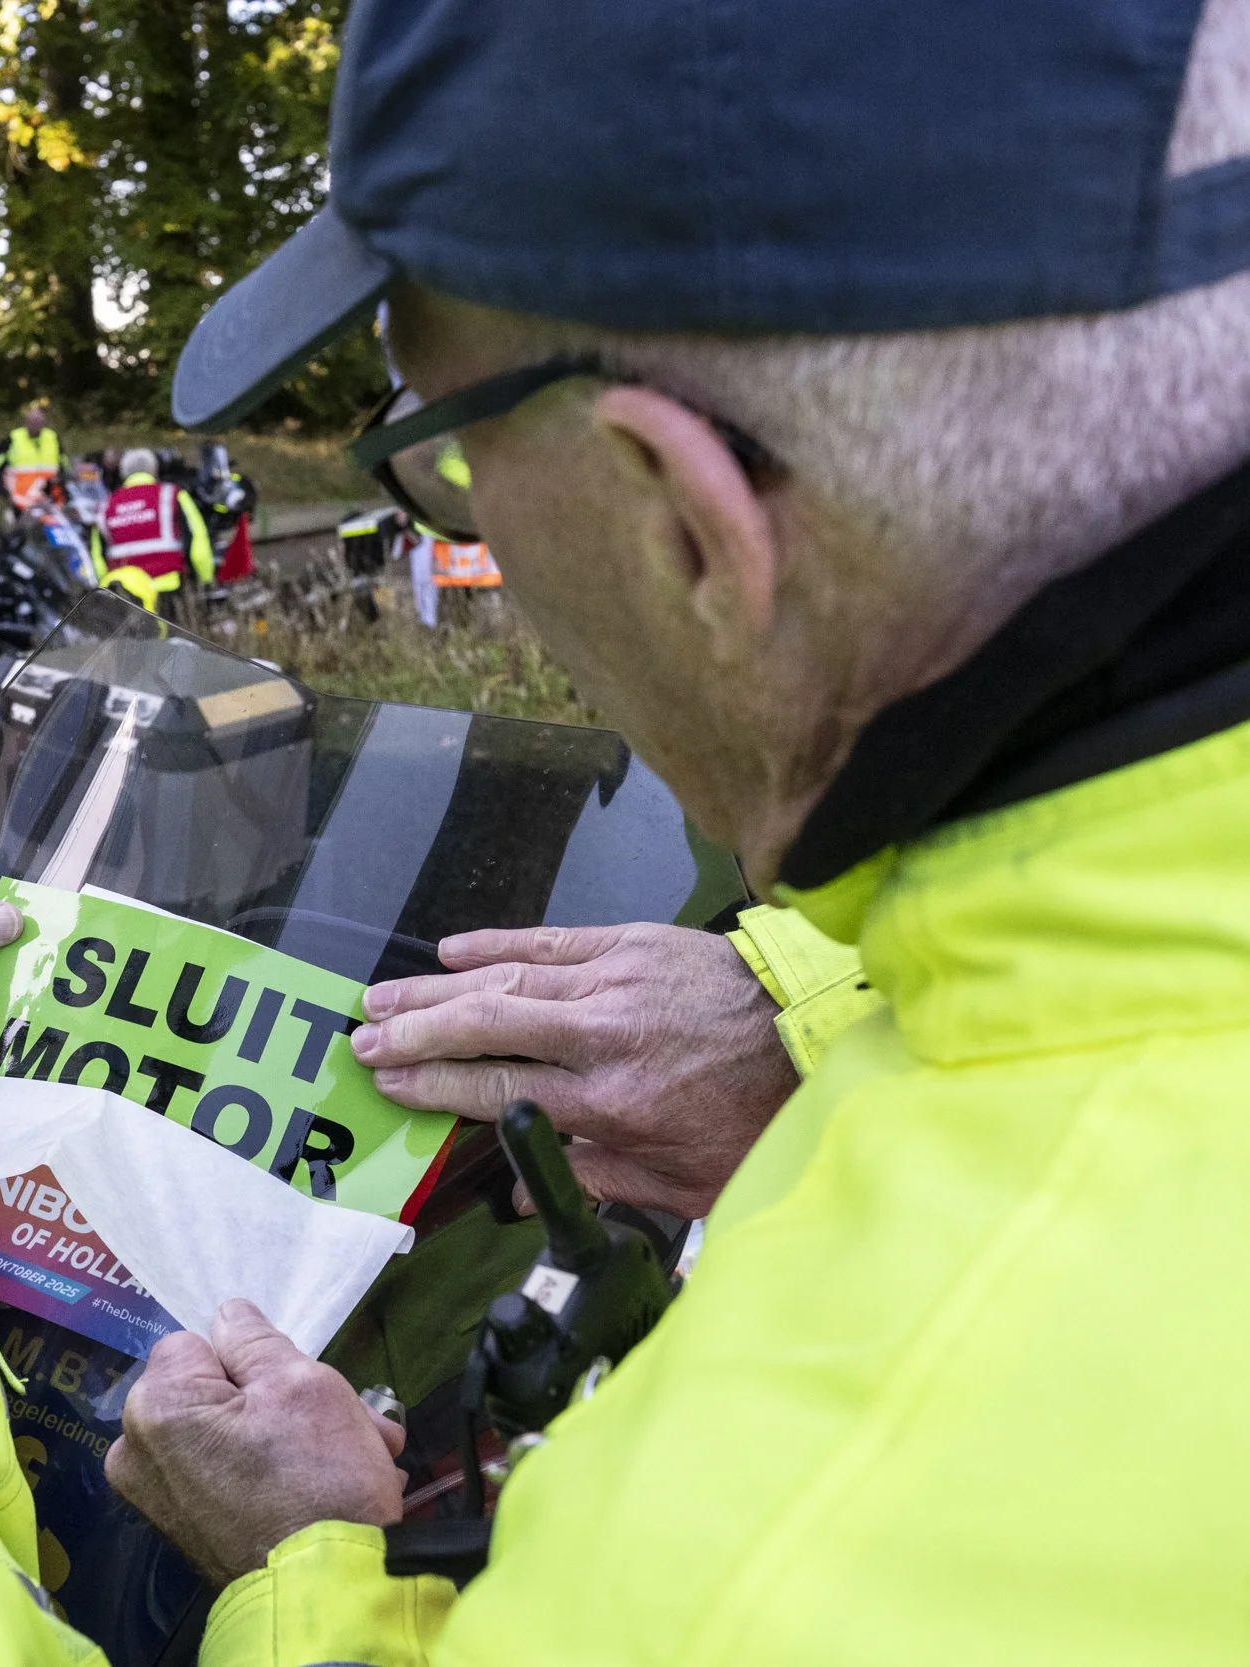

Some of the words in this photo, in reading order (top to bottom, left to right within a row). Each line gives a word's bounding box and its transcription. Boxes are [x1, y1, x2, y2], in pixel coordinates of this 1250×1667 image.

[52, 936, 363, 1084] SLUIT
[11, 1222, 52, 1250] OF
[46, 1236, 152, 1299] HOLLA
[44, 1278, 80, 1298] 2025
[91, 1297, 171, 1337] #TheDutchWa
